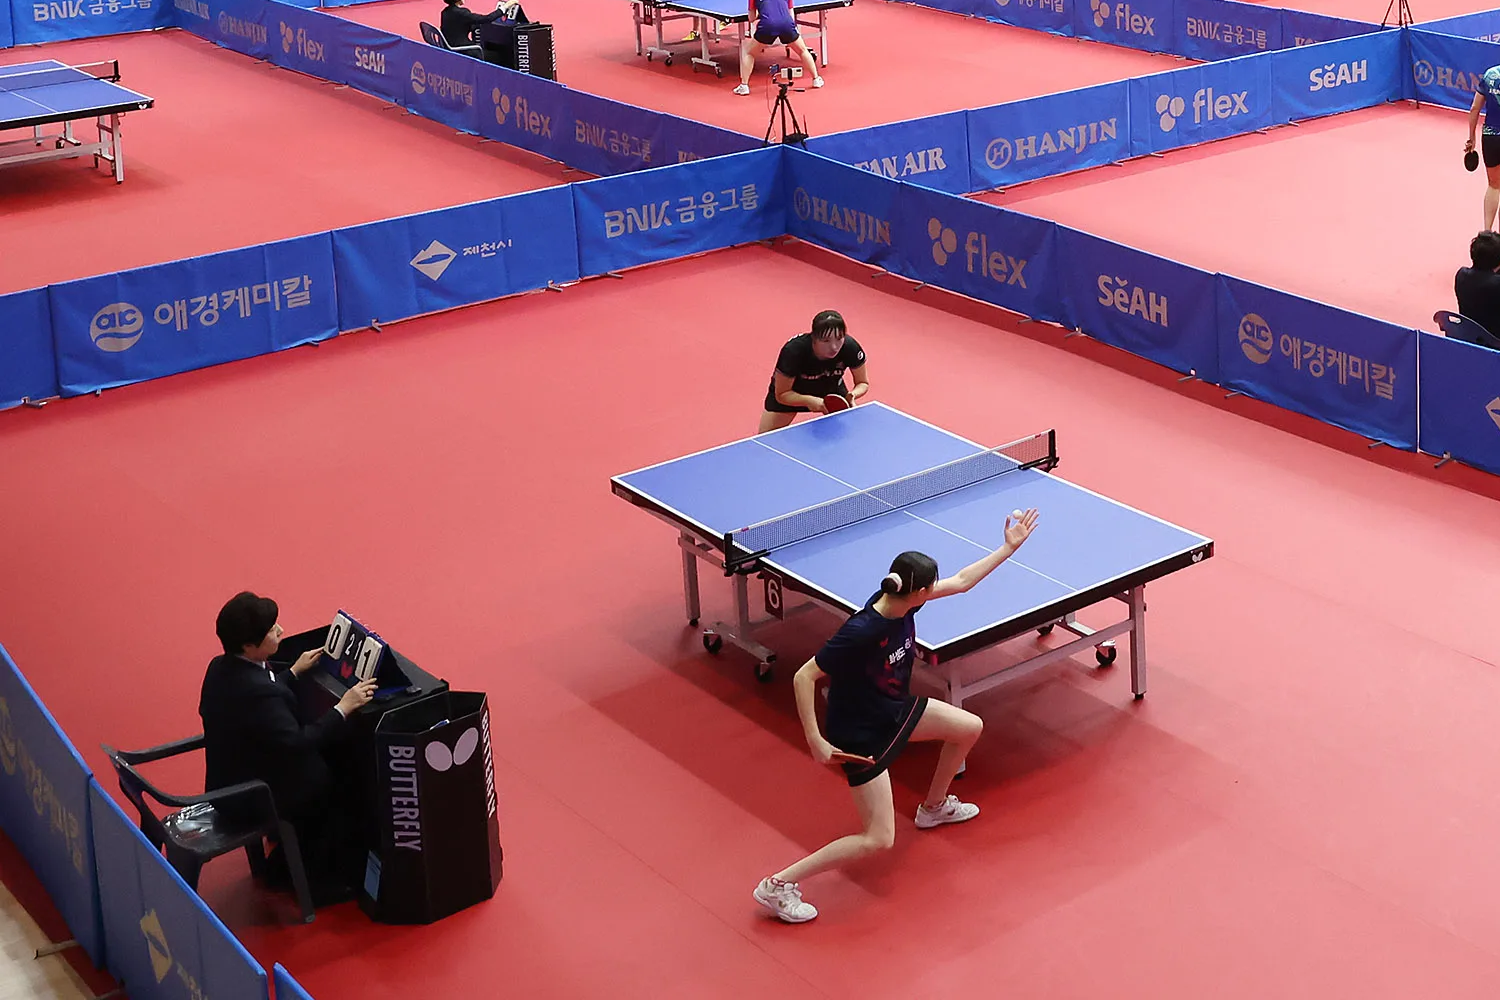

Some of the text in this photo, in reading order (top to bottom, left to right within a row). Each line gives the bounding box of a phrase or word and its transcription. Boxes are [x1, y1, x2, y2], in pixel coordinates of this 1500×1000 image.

[33, 0, 86, 22] BNK
[1115, 3, 1155, 36] flex
[297, 28, 325, 63] flex
[1187, 17, 1267, 49] BNK 금융그룹
[518, 35, 530, 74] BUTTERFL
[428, 73, 473, 107] 애경케미칼
[1193, 88, 1249, 124] flex
[515, 96, 551, 137] flex
[575, 119, 652, 163] BNK 금융그룹
[1016, 118, 1117, 160] HANJIN
[901, 147, 947, 176] AIR
[604, 183, 759, 239] BNK 금융그룹
[812, 195, 892, 247] HANJIN
[463, 238, 513, 258] 제천시
[965, 231, 1028, 289] flex
[153, 274, 312, 332] 애경케미칼
[1279, 333, 1396, 400] 애경케미칼
[768, 579, 780, 604] 6
[329, 625, 373, 678] 0 2 1 1
[388, 745, 422, 852] BUTTERFLY
